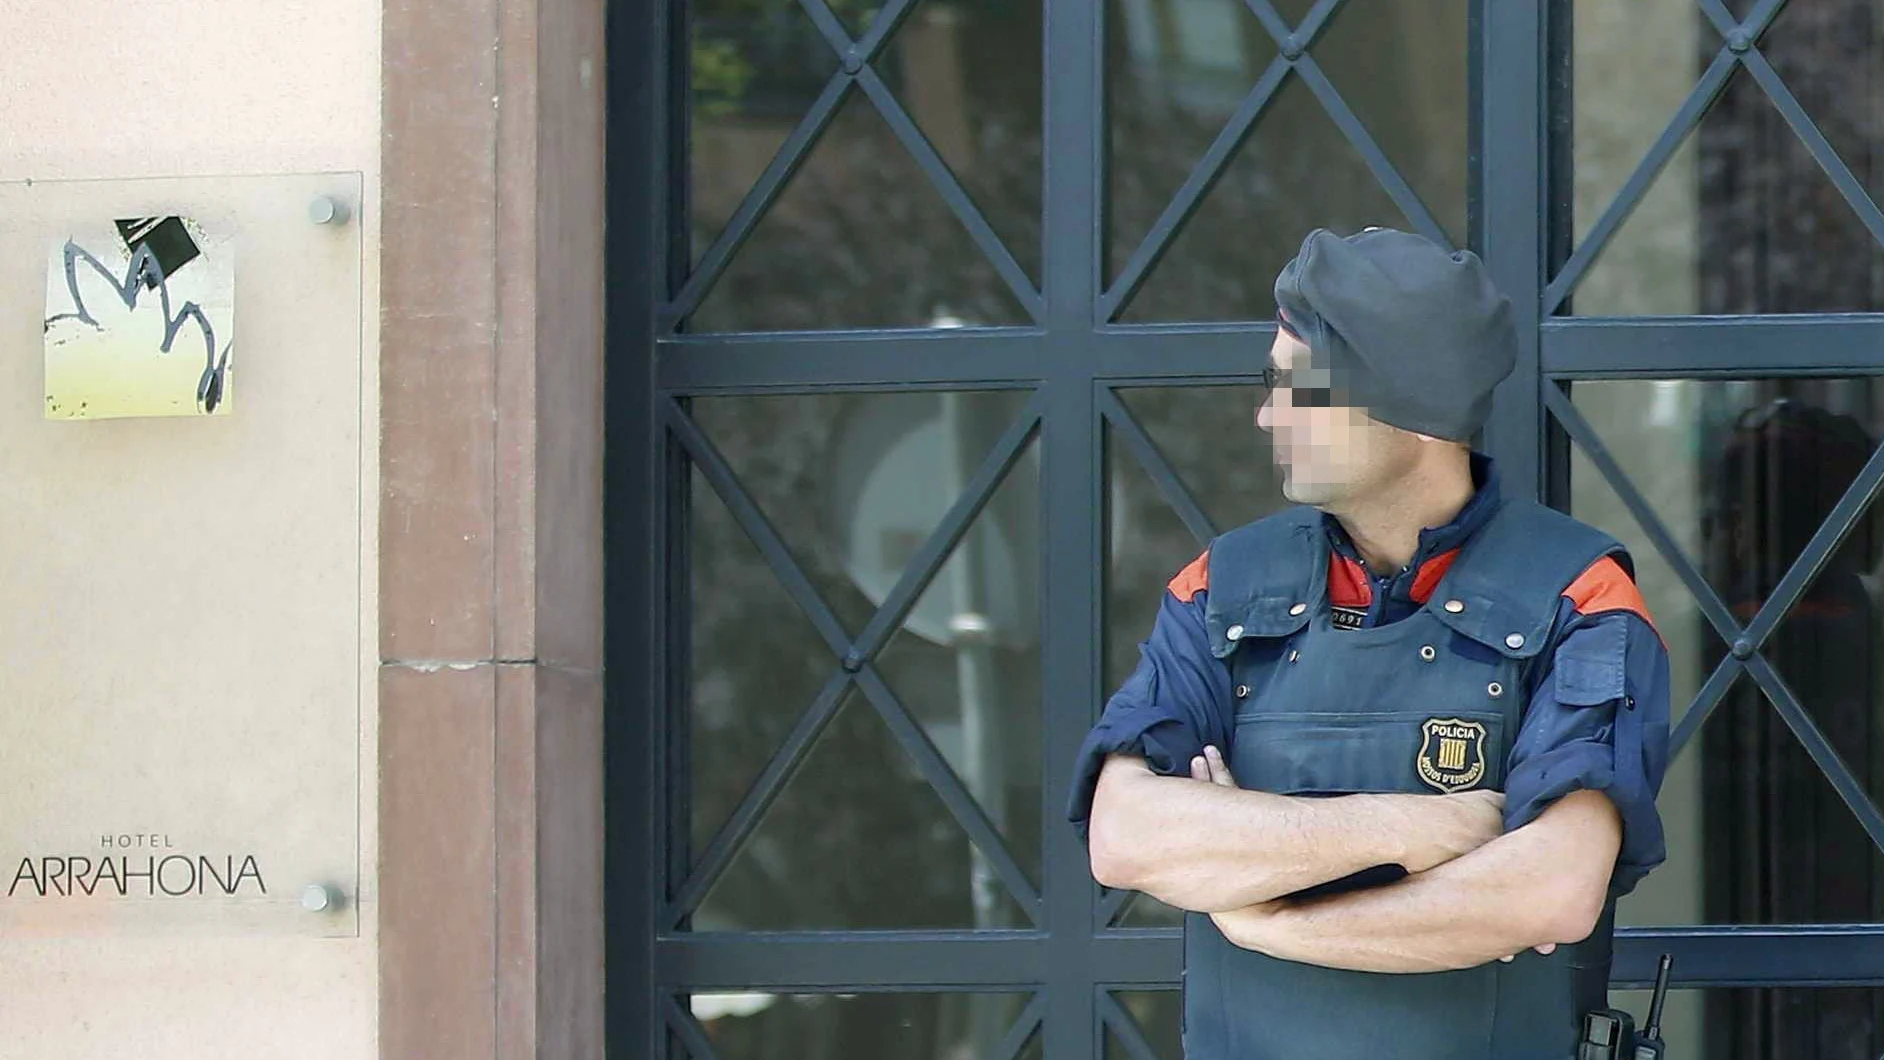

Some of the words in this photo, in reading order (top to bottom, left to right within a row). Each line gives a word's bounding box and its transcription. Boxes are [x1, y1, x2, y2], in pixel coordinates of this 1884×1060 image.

[1431, 725, 1475, 739] POLICIA
[101, 834, 173, 848] HOTEL
[8, 855, 267, 896] ARRAHONA
